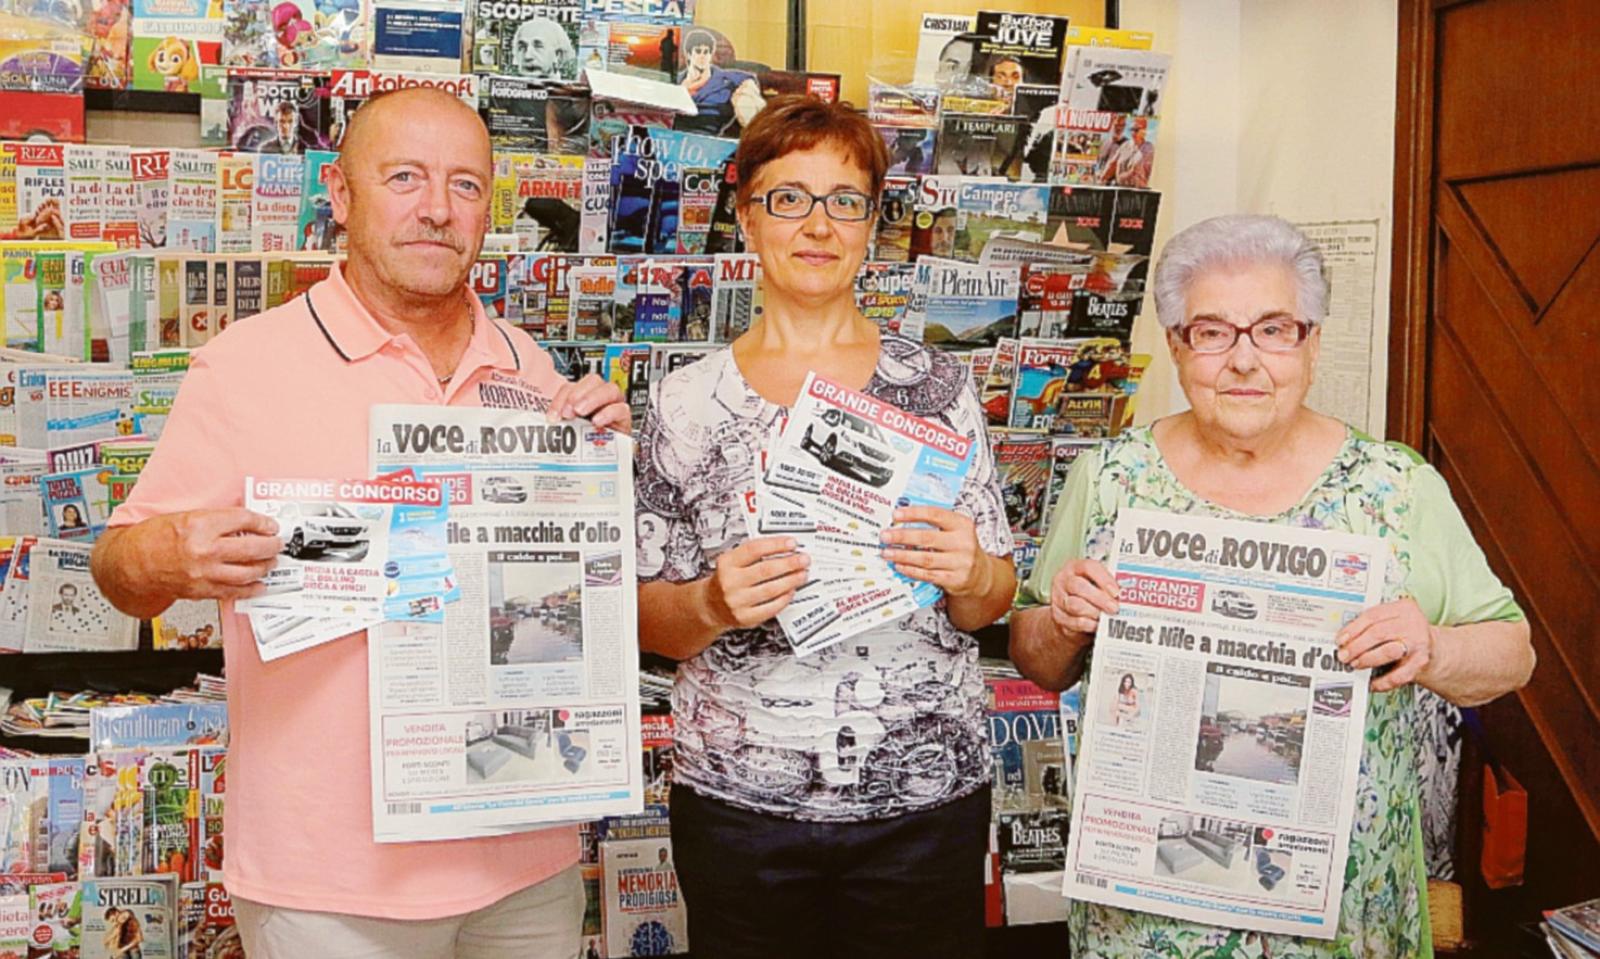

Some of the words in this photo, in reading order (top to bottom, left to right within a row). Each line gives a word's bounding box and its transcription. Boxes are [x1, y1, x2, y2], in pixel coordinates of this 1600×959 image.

[479, 3, 583, 22] SCOPERTE
[990, 28, 1053, 47] JUVE
[20, 146, 58, 160] RIZA
[625, 124, 674, 158] how
[679, 136, 704, 163] to
[173, 160, 217, 173] SALUTE
[173, 184, 189, 196] La
[518, 179, 567, 199] ARMI
[961, 182, 1020, 204] Camper
[172, 197, 193, 208] che
[256, 201, 268, 213] La
[271, 201, 298, 214] dieta
[1088, 296, 1128, 319] BEATLES
[1067, 399, 1102, 410] ALVIN
[812, 378, 881, 420] GRANDE
[882, 408, 969, 457] CONCORSO
[376, 437, 392, 454] la
[392, 423, 464, 454] VOCE
[465, 439, 479, 454] di
[480, 424, 577, 454] ROVIGO
[255, 480, 335, 498] GRANDE
[339, 481, 441, 503] CONCORSO
[476, 527, 489, 544] a
[494, 520, 564, 544] macchia
[568, 521, 621, 544] d'olio
[1118, 538, 1133, 554] la
[1136, 526, 1206, 561] VOCE
[1204, 549, 1219, 566] di
[1219, 536, 1328, 578] ROVIGO
[1118, 587, 1198, 610] CONCORSO
[1138, 579, 1200, 597] GRANDE
[1107, 618, 1153, 645] West
[1158, 625, 1195, 651] Nile
[1199, 634, 1211, 654] a
[1216, 637, 1296, 667] macchia
[403, 724, 447, 734] VENDITA
[1011, 816, 1061, 848] BEATLES
[617, 871, 678, 893] MEMORIA
[619, 891, 678, 909] PRODIGIOSA
